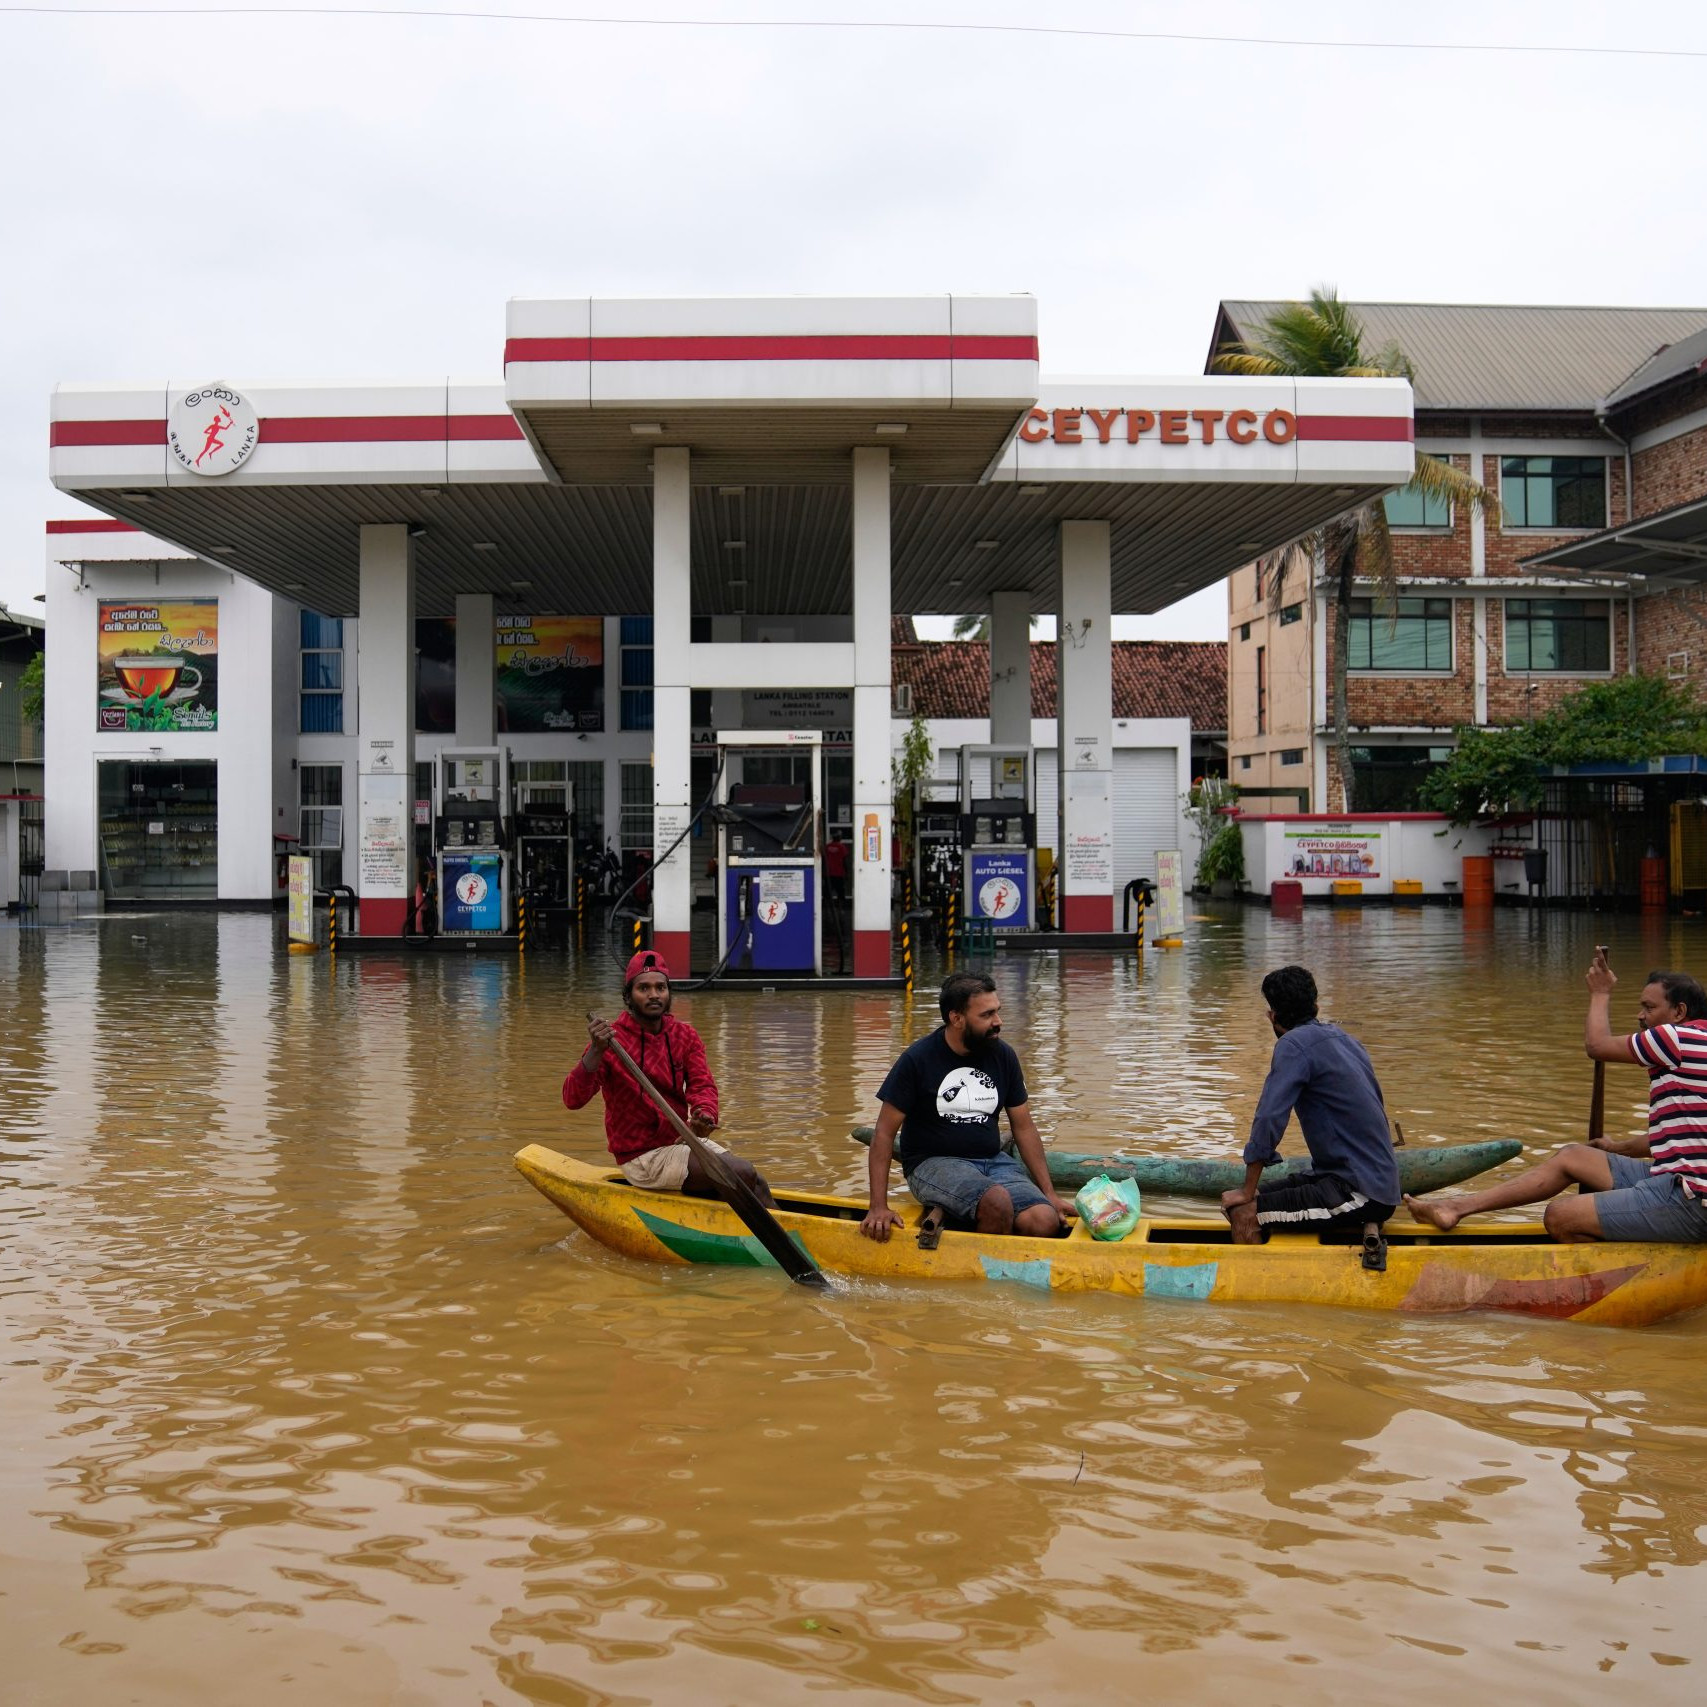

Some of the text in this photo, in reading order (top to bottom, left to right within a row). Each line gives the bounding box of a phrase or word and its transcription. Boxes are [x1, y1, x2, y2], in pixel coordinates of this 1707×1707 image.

[185, 388, 240, 407] ලංකා
[1018, 408, 1297, 444] CEYPETCO
[231, 425, 255, 465] LANKA
[753, 692, 849, 700] LANKA FILLING STATION
[691, 732, 717, 744] LAN
